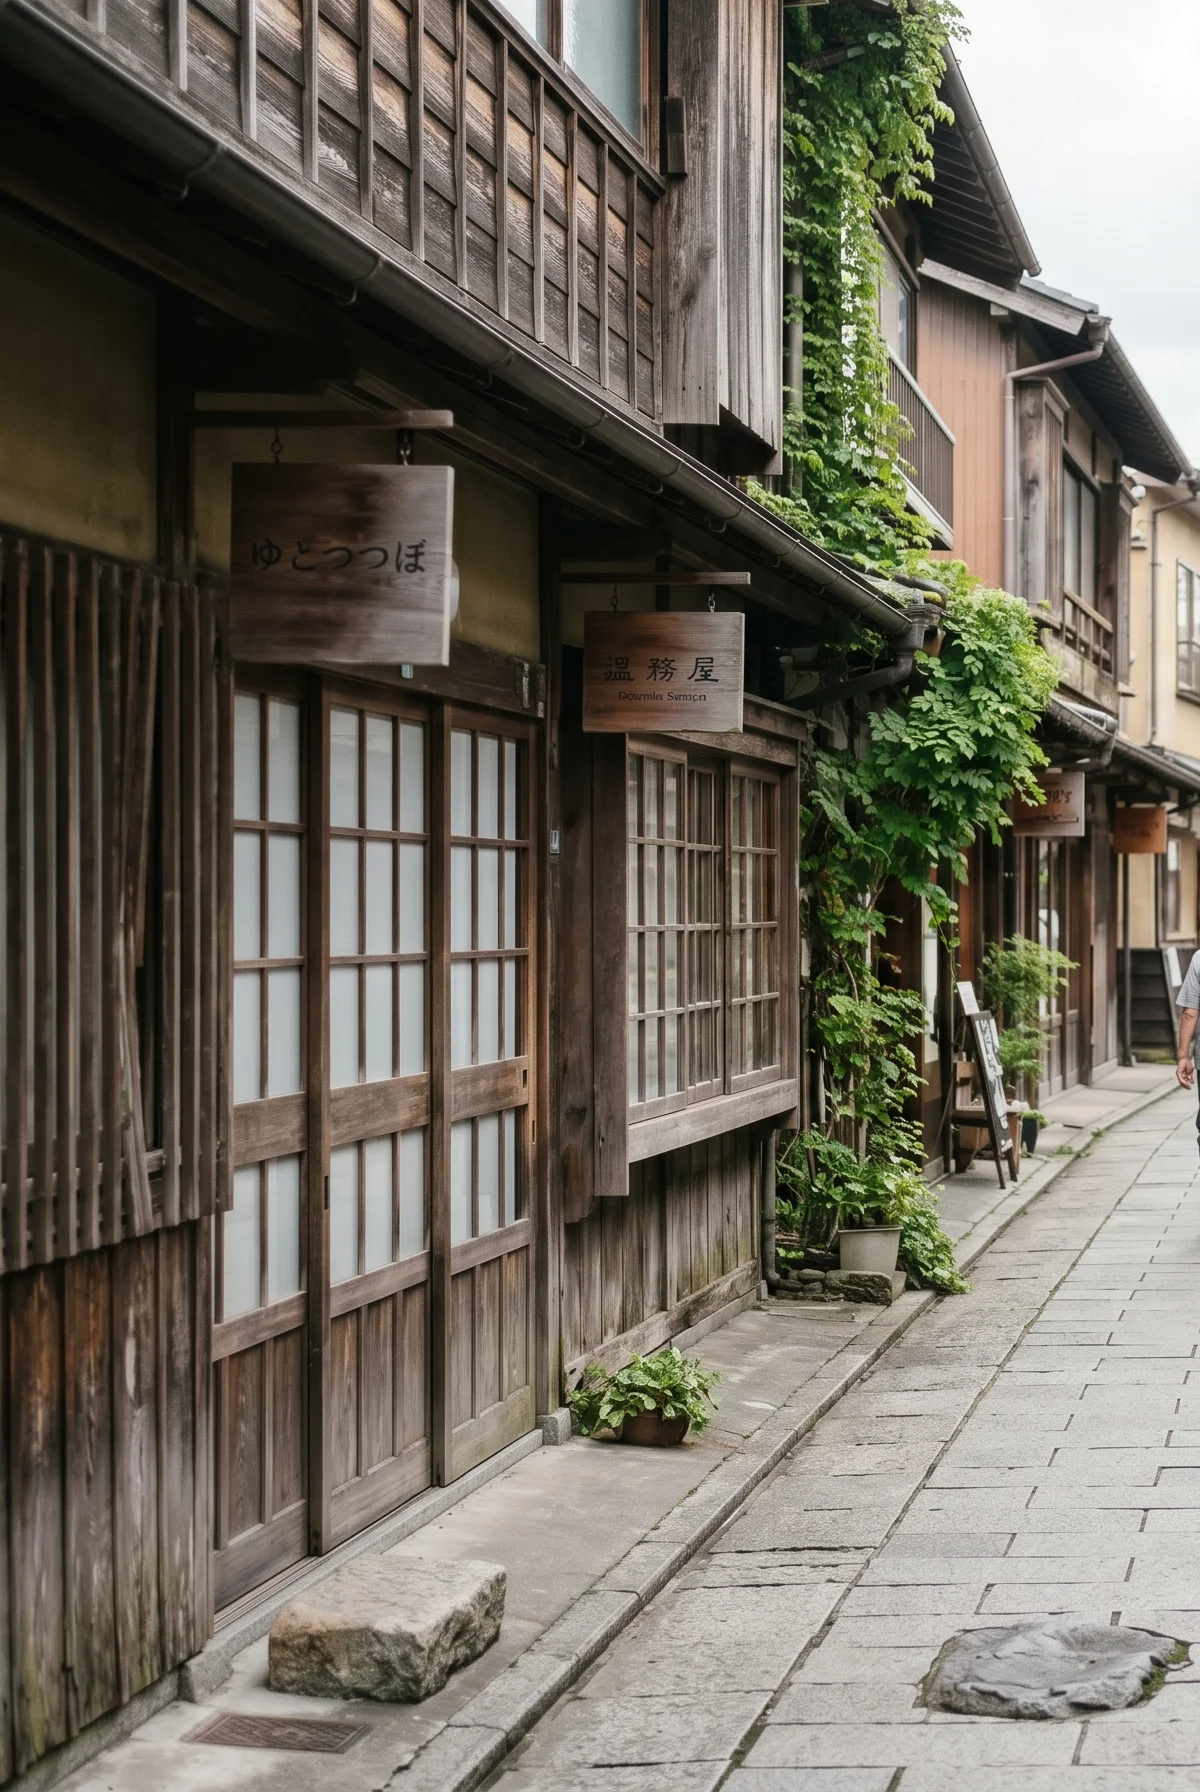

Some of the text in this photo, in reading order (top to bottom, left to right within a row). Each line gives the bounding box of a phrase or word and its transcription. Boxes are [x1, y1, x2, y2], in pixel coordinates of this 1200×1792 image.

[252, 537, 427, 573] ゆとつつぼ
